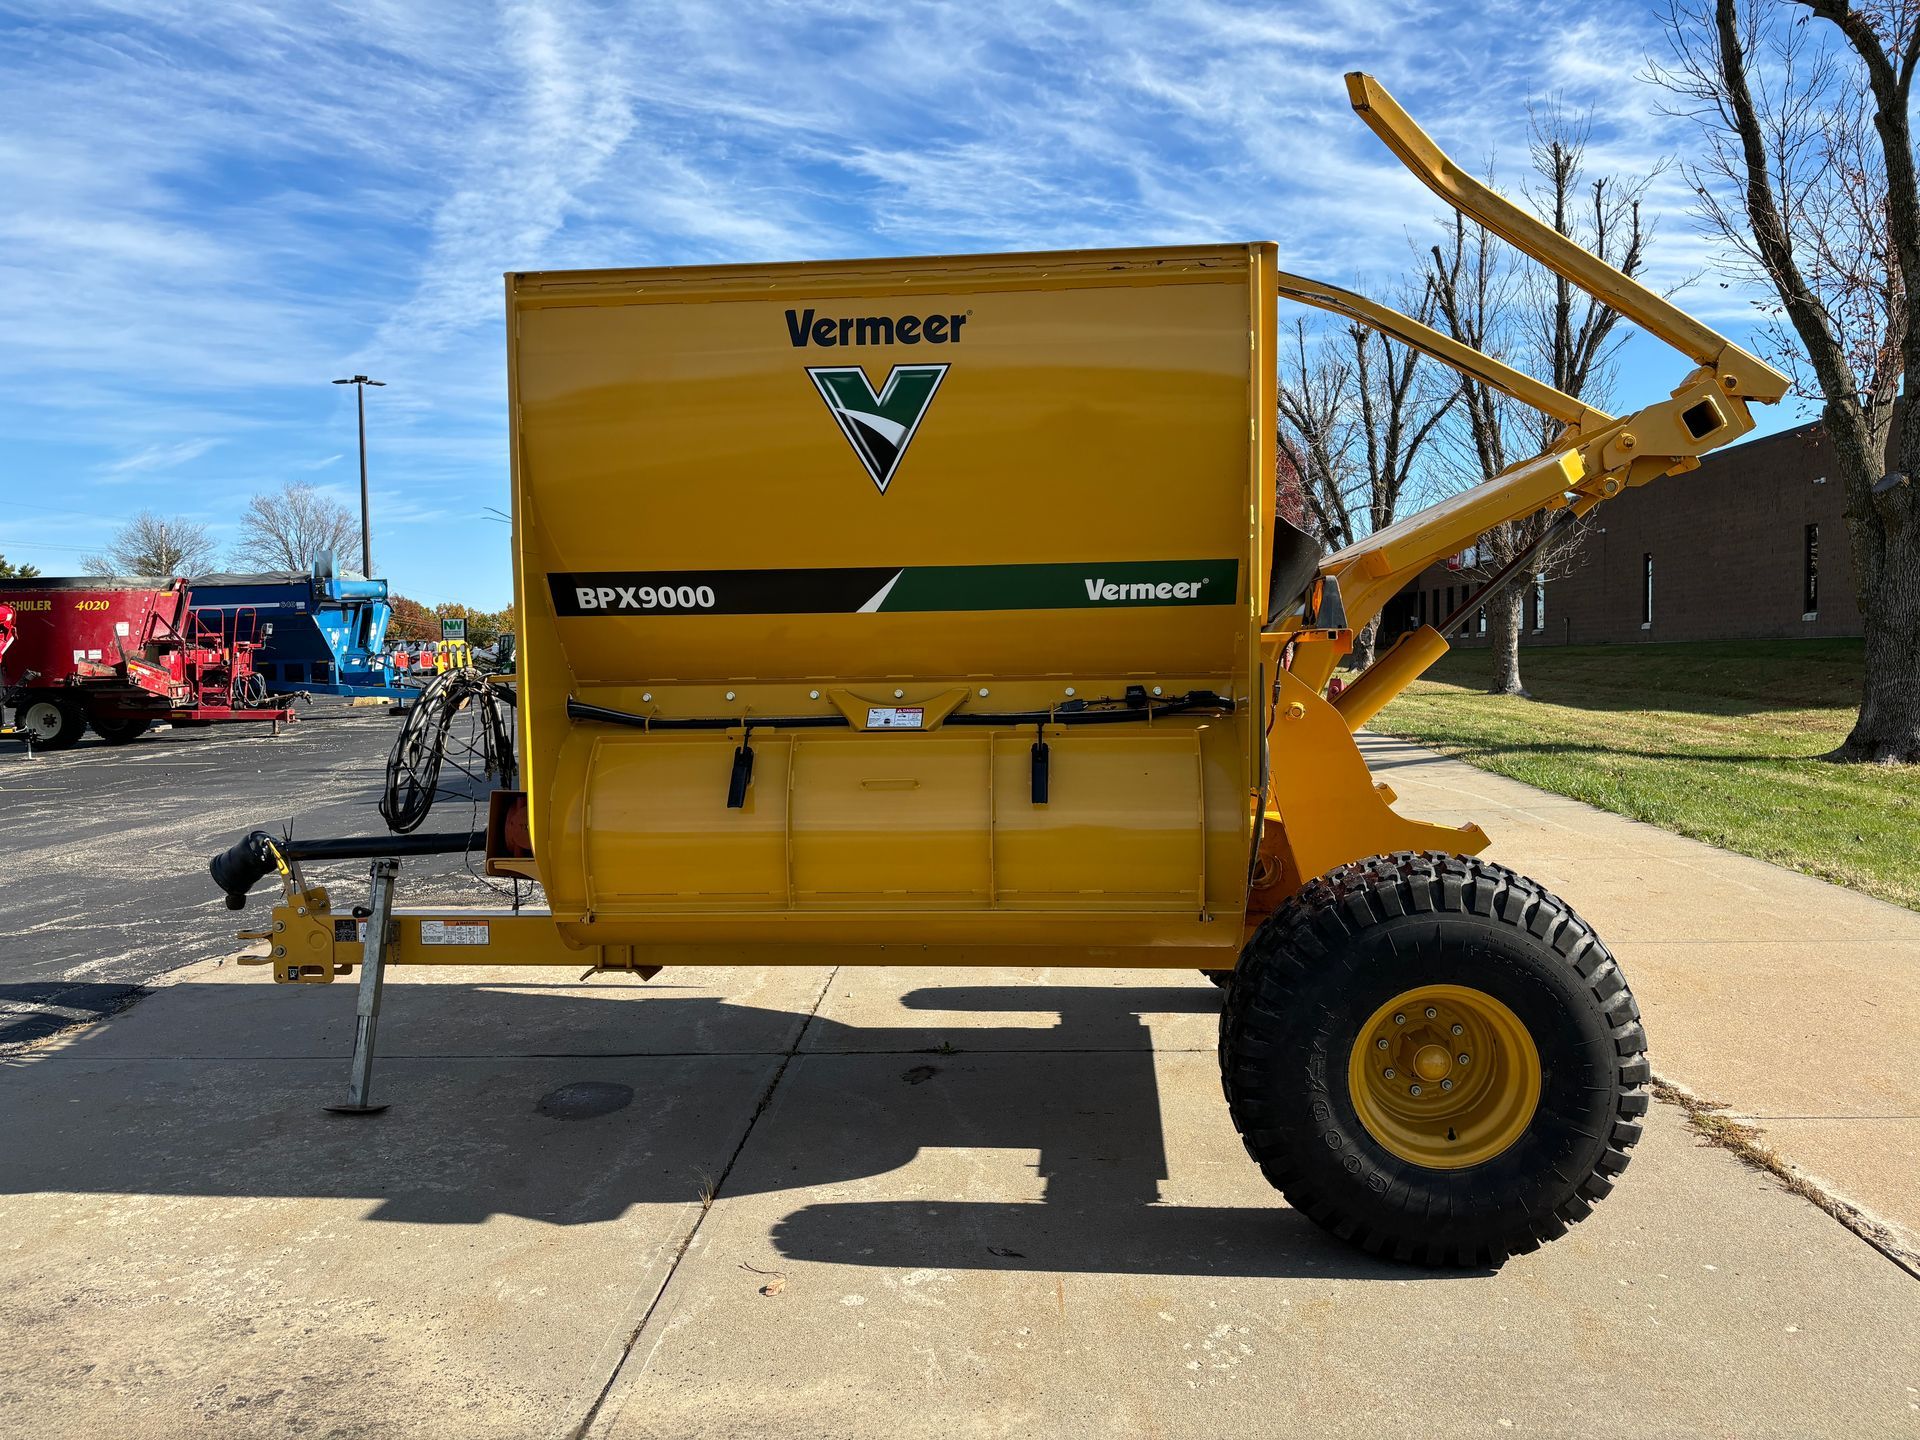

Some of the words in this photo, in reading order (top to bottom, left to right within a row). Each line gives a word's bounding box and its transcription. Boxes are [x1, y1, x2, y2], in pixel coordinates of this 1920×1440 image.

[3, 600, 52, 611] CHULER
[74, 600, 110, 611] 4020
[575, 585, 716, 609] BPX9000
